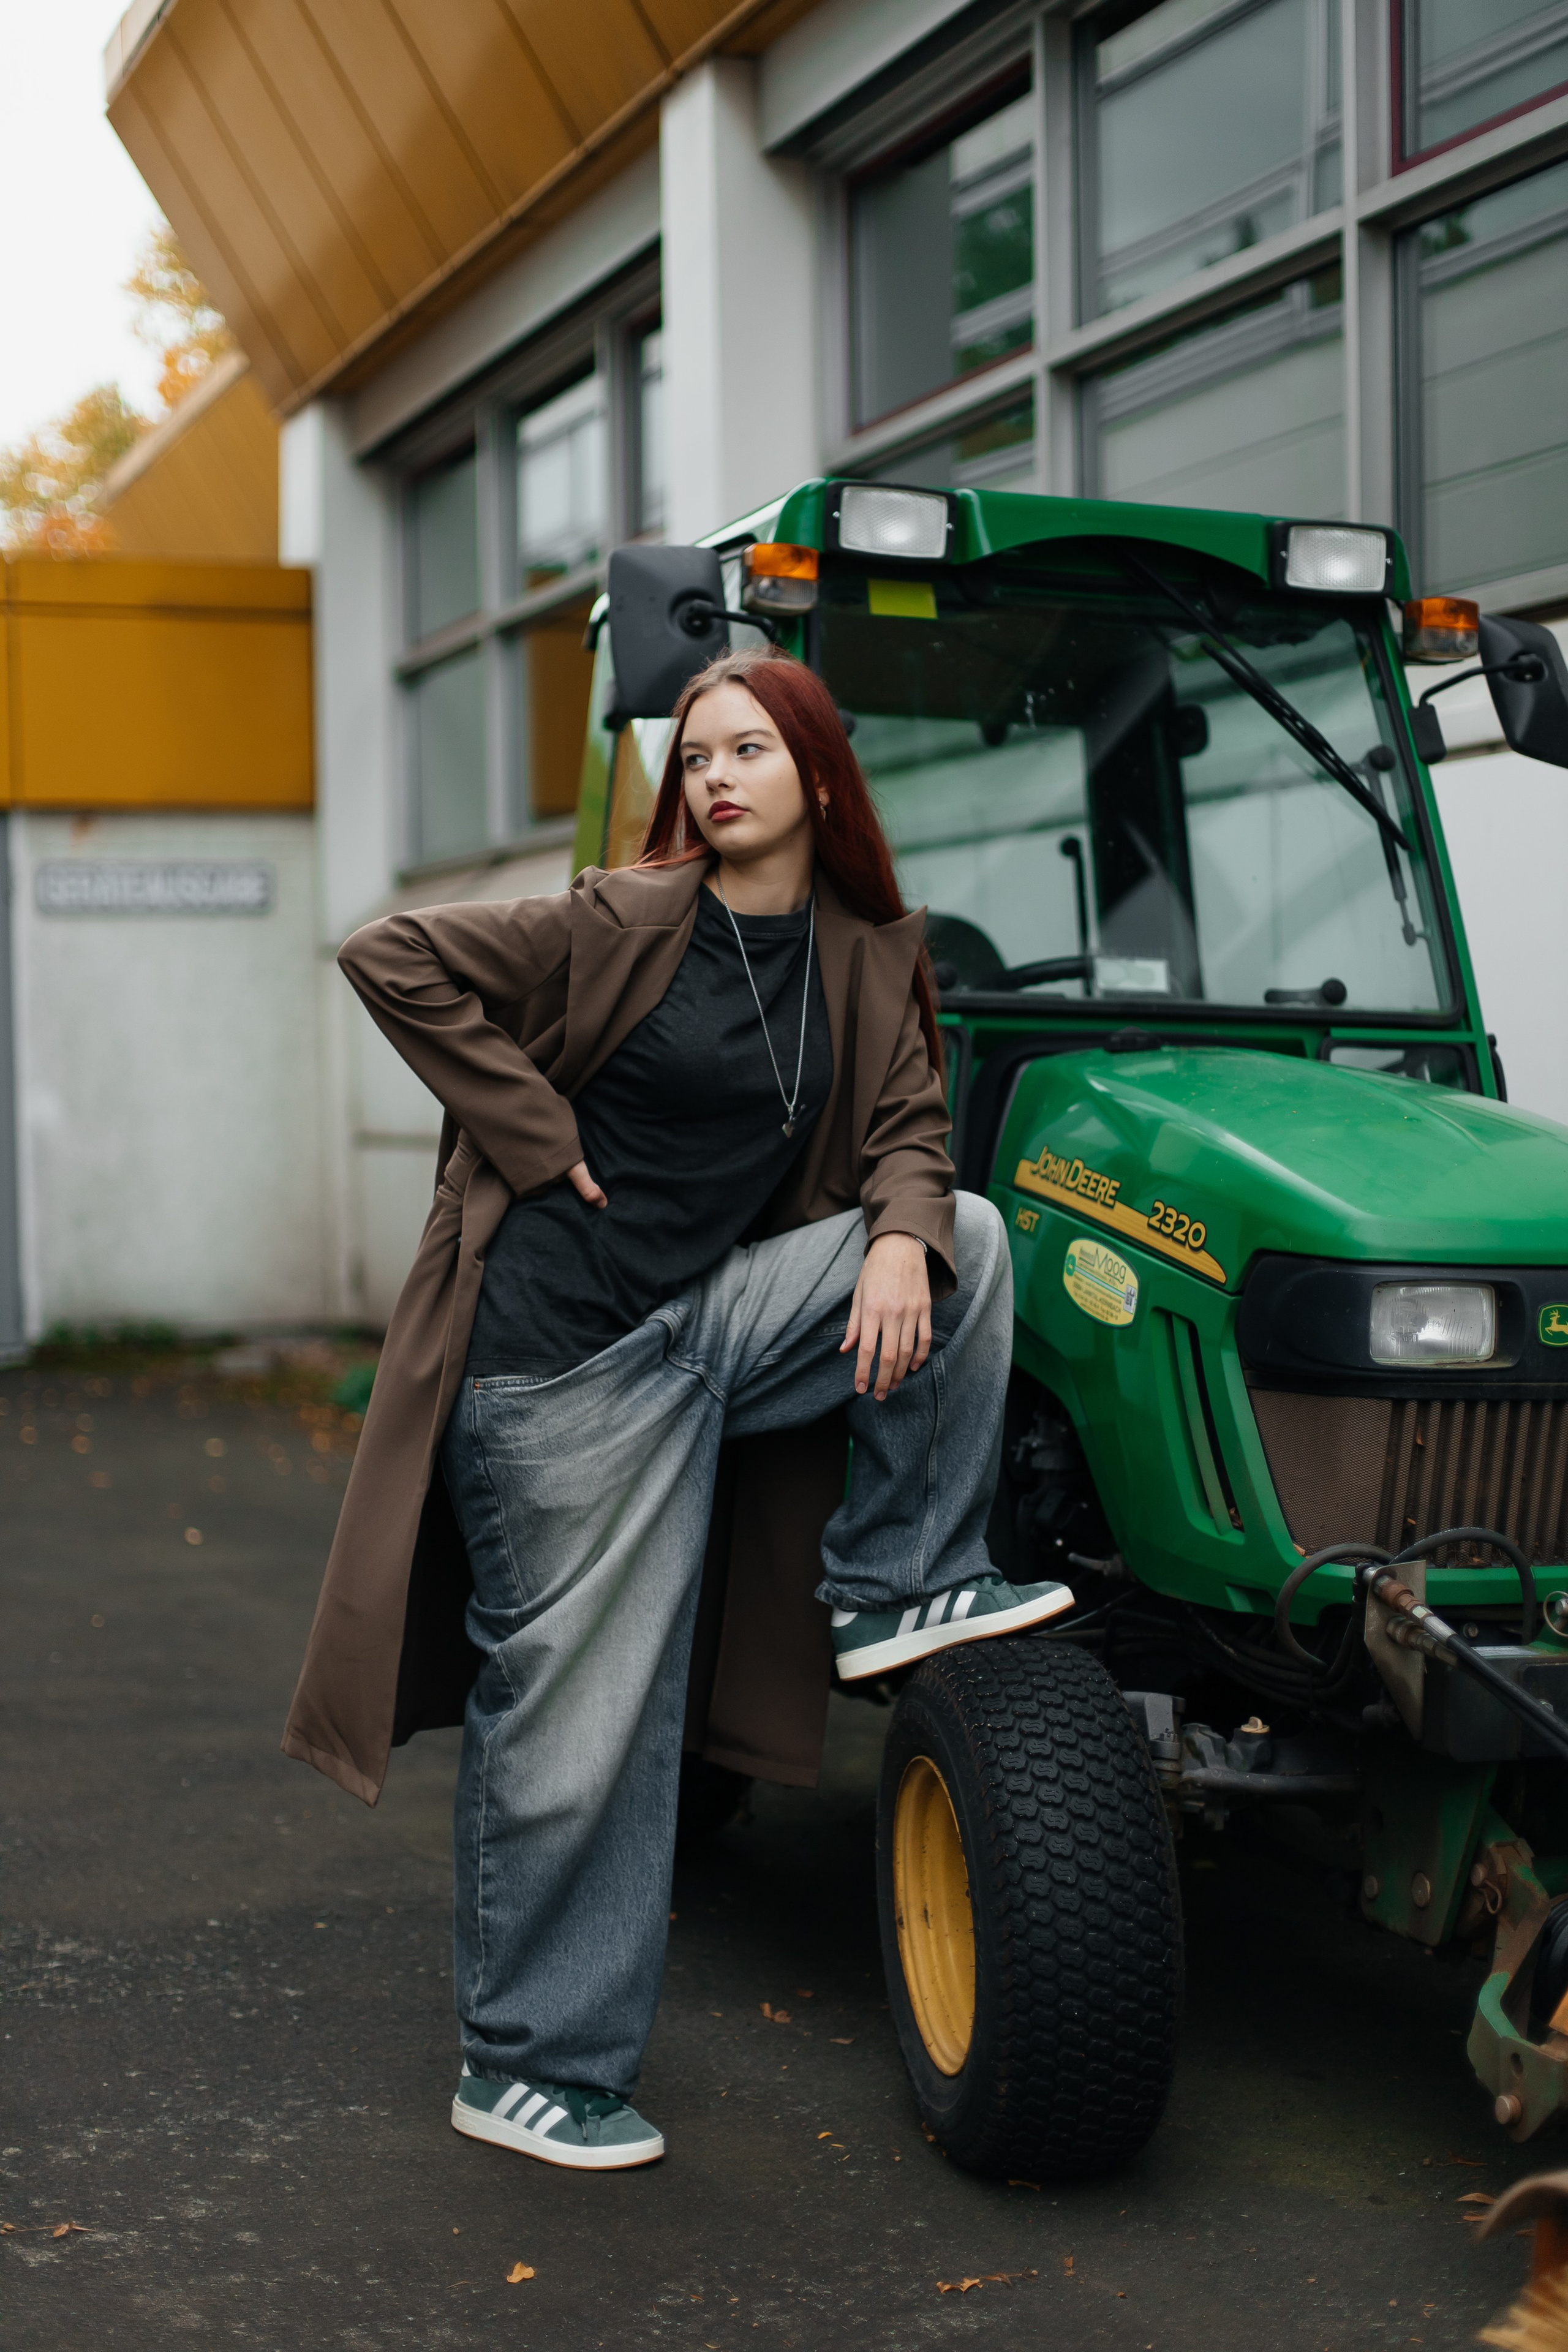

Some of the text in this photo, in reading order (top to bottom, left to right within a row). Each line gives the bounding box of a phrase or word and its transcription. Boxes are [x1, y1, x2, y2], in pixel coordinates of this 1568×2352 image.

[1015, 1207, 1040, 1232] HST
[1030, 1145, 1206, 1248] JOHN DEERE 2320
